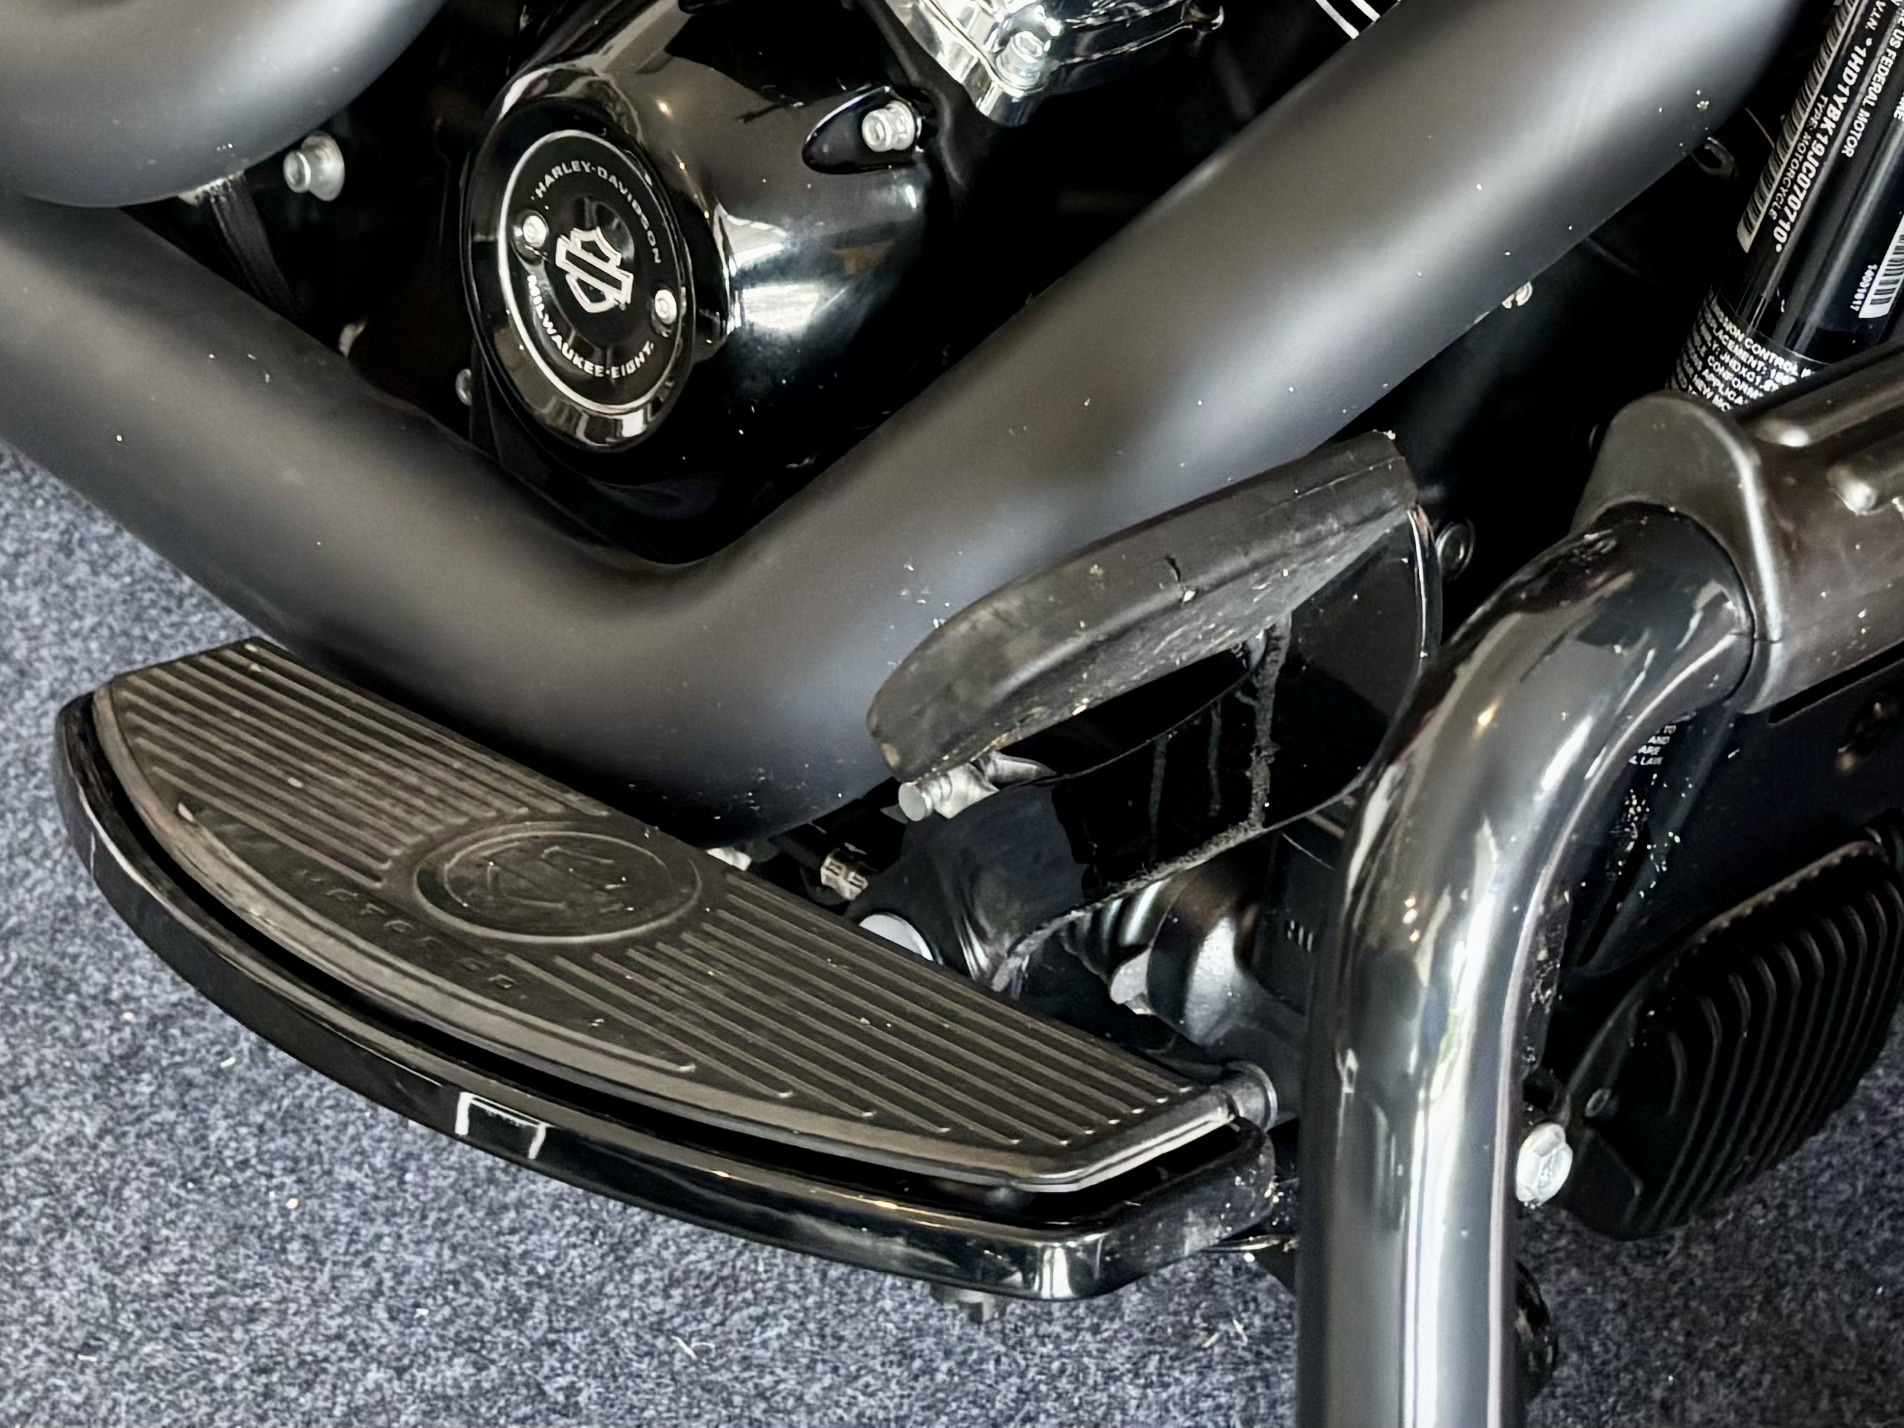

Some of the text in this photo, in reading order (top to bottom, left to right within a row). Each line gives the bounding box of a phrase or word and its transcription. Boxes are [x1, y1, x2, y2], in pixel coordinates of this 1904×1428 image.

[1889, 28, 1904, 48] US
[1862, 48, 1897, 106] FEDERAL
[1842, 108, 1870, 157] MOTOR
[1769, 132, 1812, 220] MOTORCYCLE
[536, 160, 662, 264] HARLEY-DAVIDSON
[526, 274, 655, 379] MILWAUKEE-EIGHT
[1745, 337, 1799, 377] CONTROL
